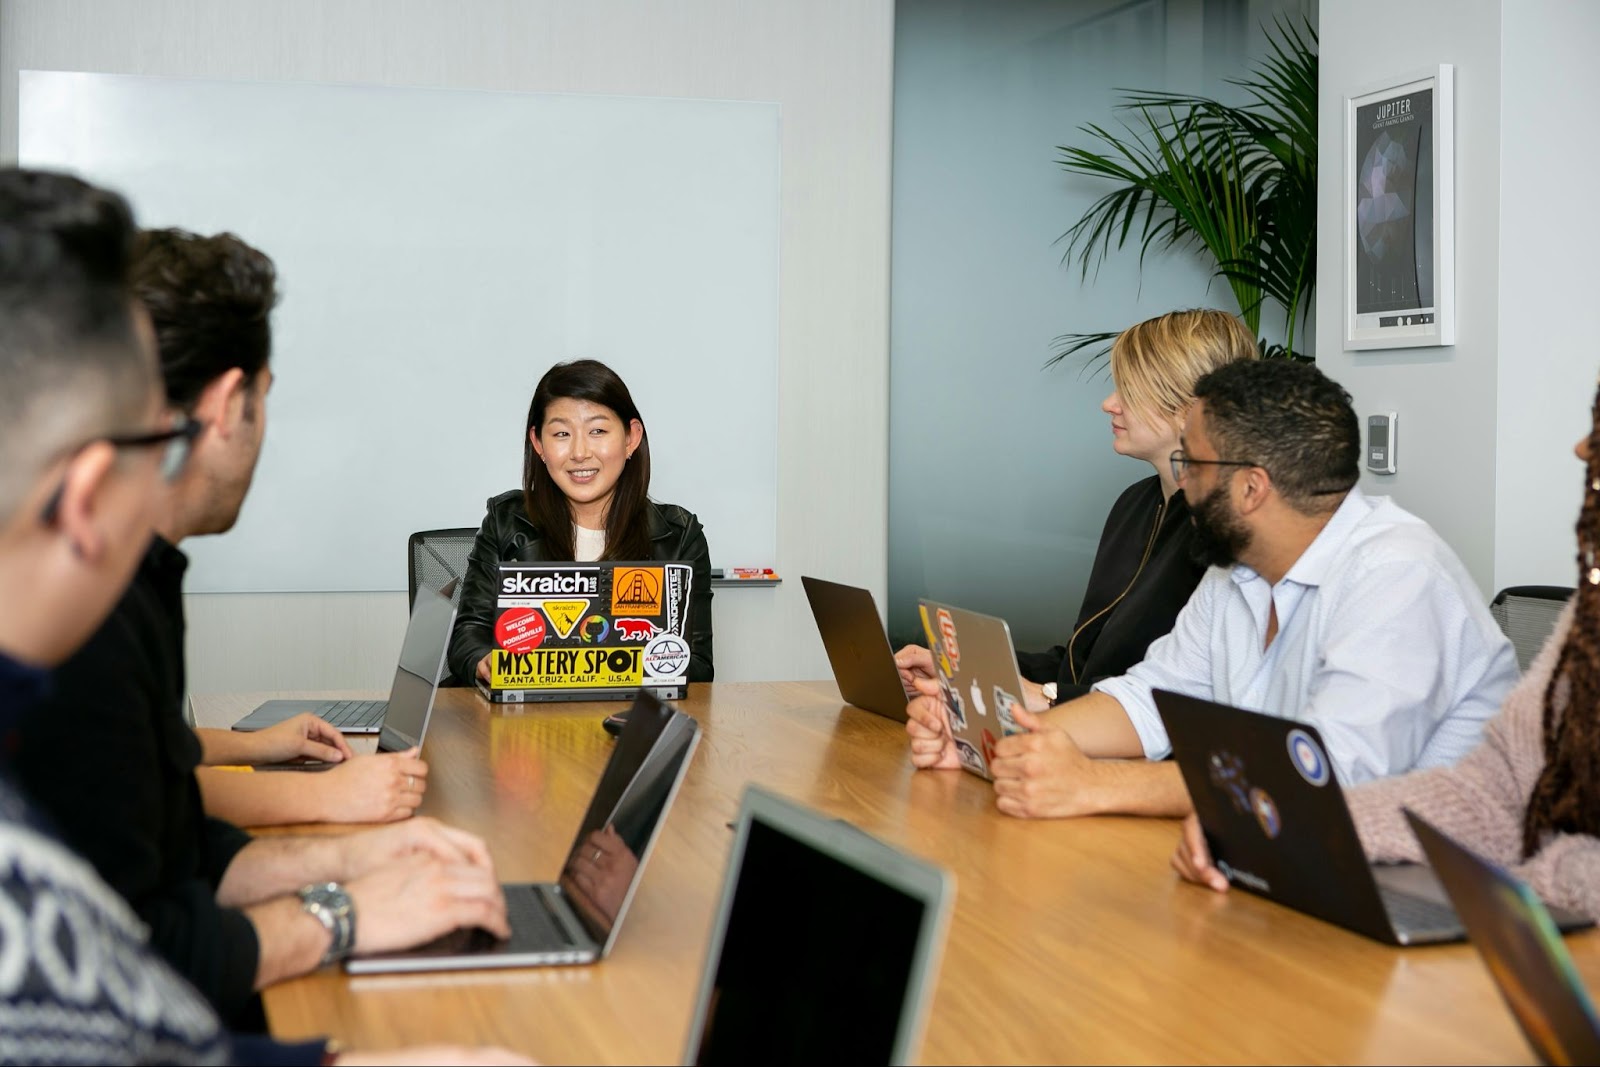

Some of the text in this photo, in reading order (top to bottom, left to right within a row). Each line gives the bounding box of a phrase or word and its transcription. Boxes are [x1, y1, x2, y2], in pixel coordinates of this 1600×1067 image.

[1376, 99, 1411, 120] JUPITER
[502, 572, 589, 593] skratch
[589, 577, 597, 592] LABS
[670, 569, 679, 624] NORMATEC
[505, 615, 536, 632] WELCOME
[517, 626, 527, 634] TO
[503, 626, 543, 646] PODIUMVILLE
[498, 649, 642, 675] MYSTERY SPOT
[503, 676, 535, 684] SANTA
[539, 675, 567, 684] CRUZ,
[570, 675, 598, 683] CALIF.
